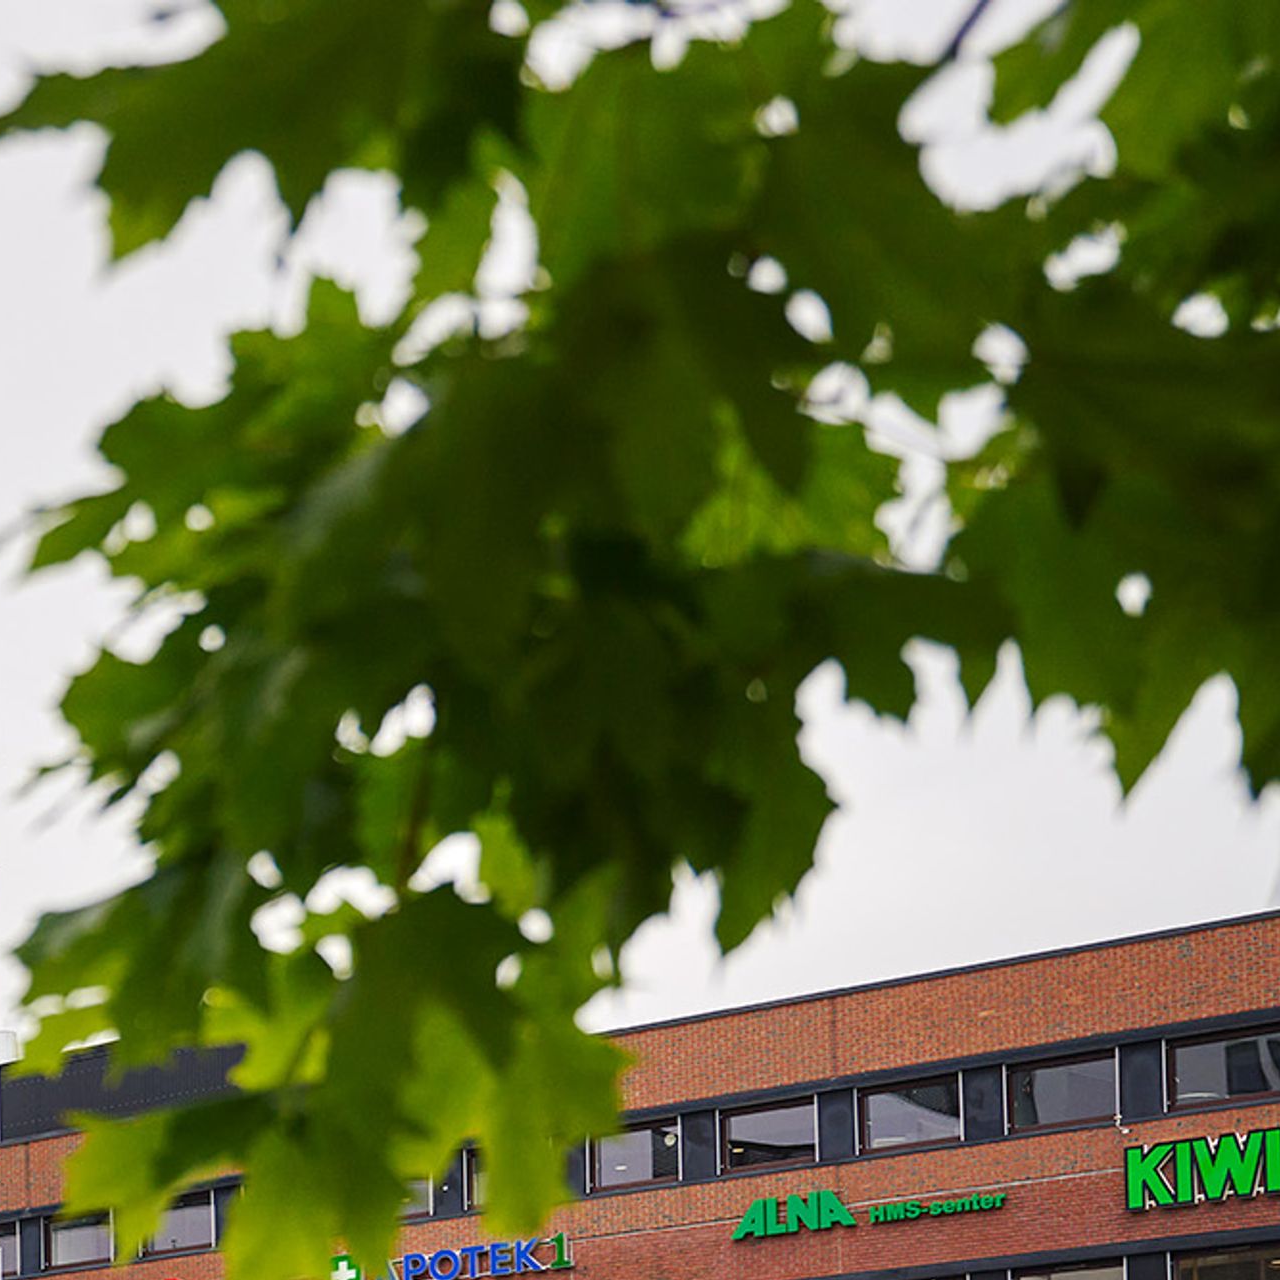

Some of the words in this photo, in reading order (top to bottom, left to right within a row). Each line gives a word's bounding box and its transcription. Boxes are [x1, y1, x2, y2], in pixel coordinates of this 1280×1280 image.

[1125, 1127, 1280, 1211] KIWI
[731, 1189, 857, 1240] ALNA
[868, 1193, 1007, 1224] HMS-senter
[550, 1232, 572, 1268] 1
